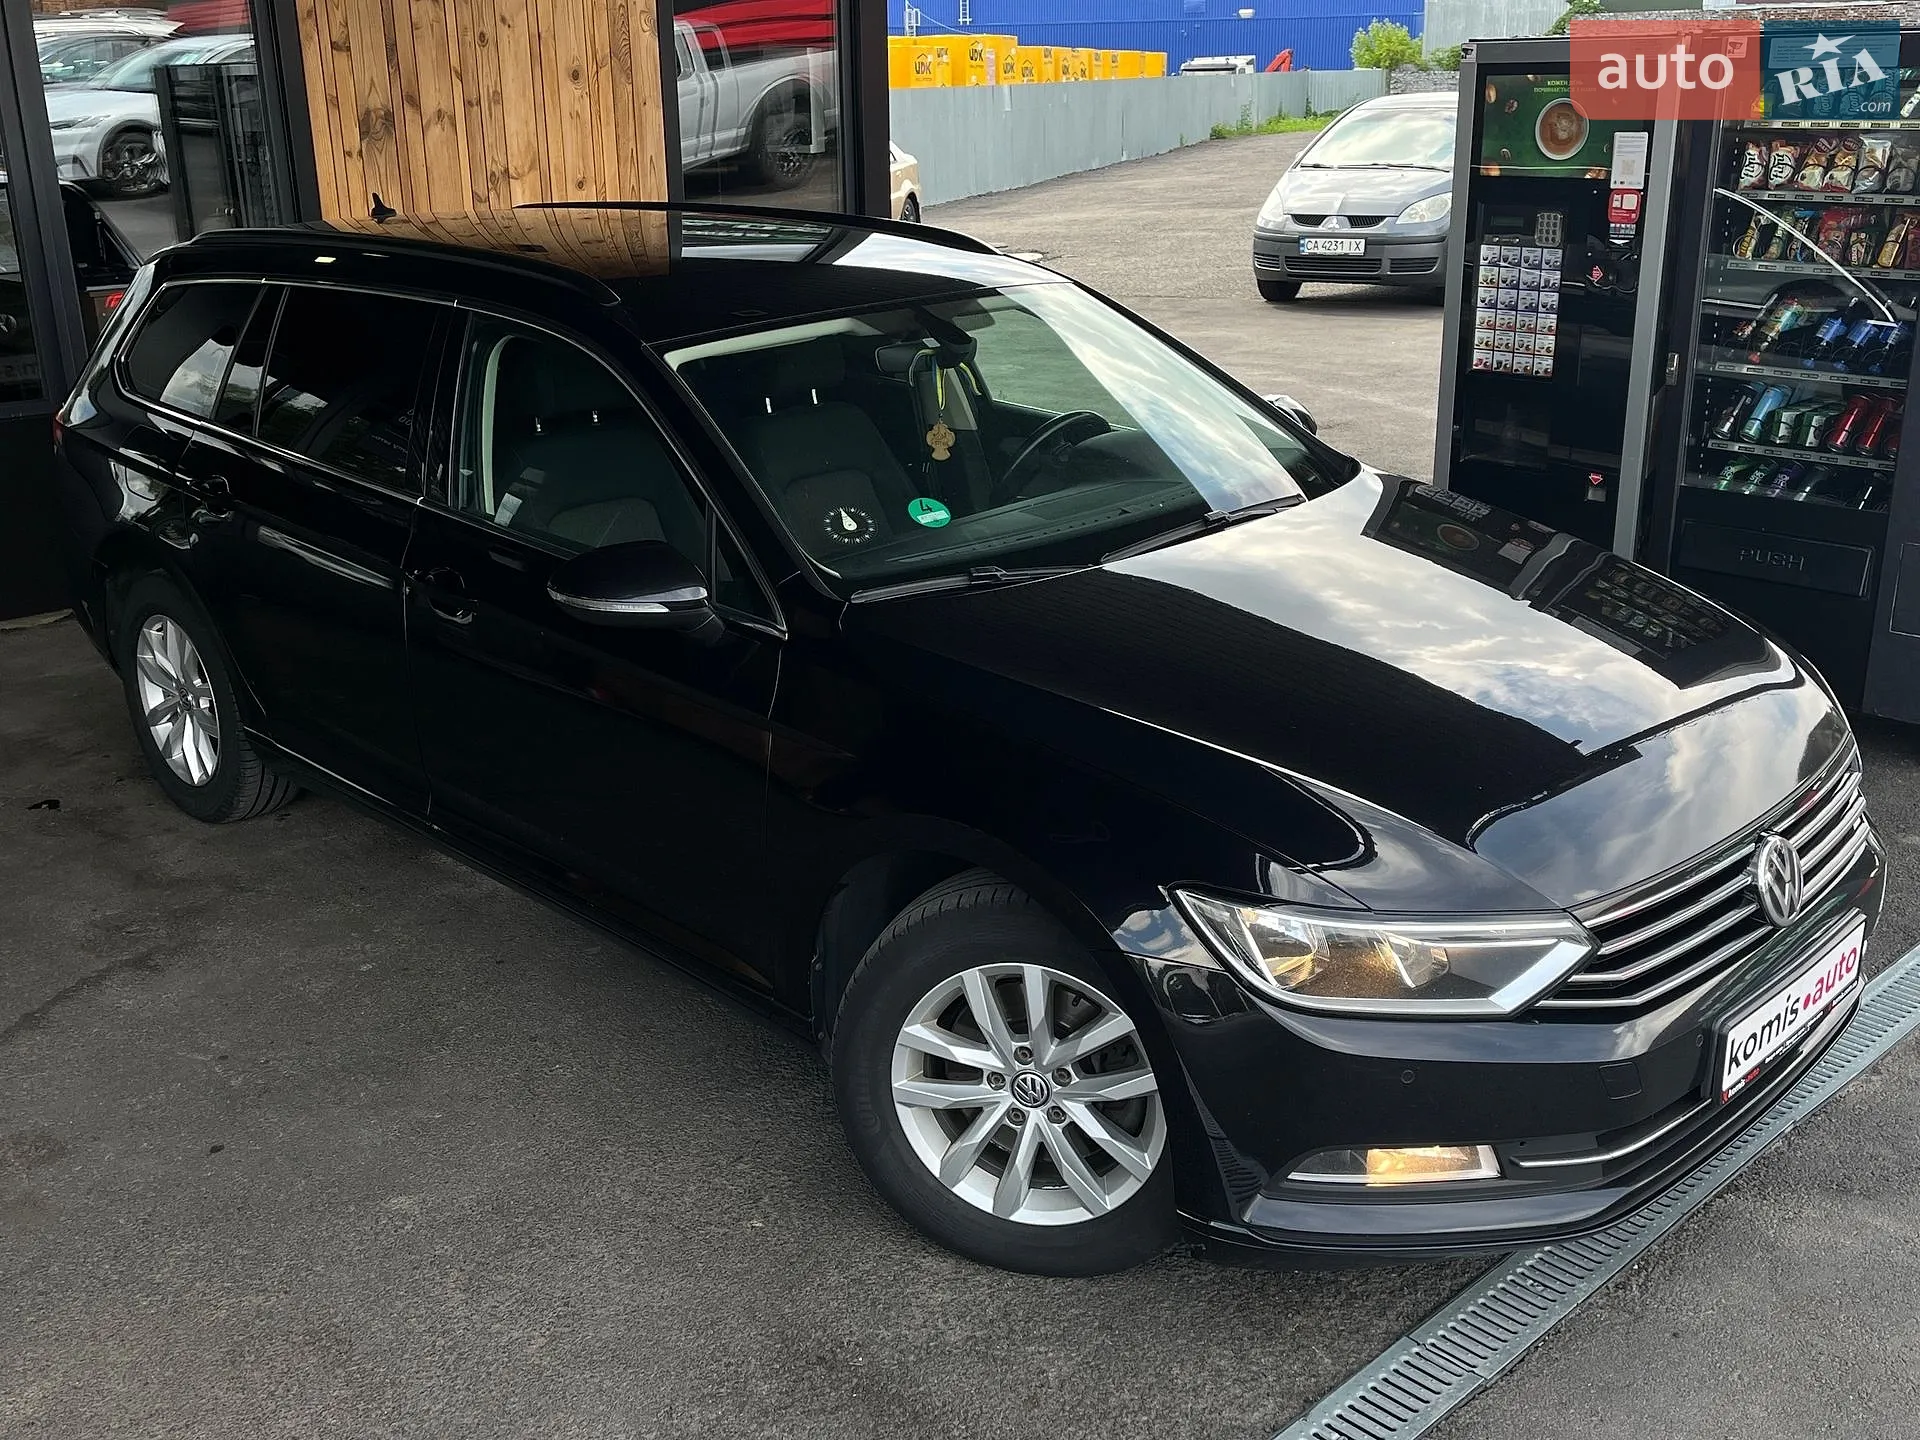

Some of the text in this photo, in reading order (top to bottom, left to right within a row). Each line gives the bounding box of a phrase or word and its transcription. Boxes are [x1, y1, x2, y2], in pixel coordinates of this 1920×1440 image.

[969, 48, 984, 62] UDK
[915, 61, 932, 75] UDK
[1306, 240, 1362, 251] CA 4231 IX
[919, 499, 932, 512] 4
[1740, 549, 1804, 571] PUSH
